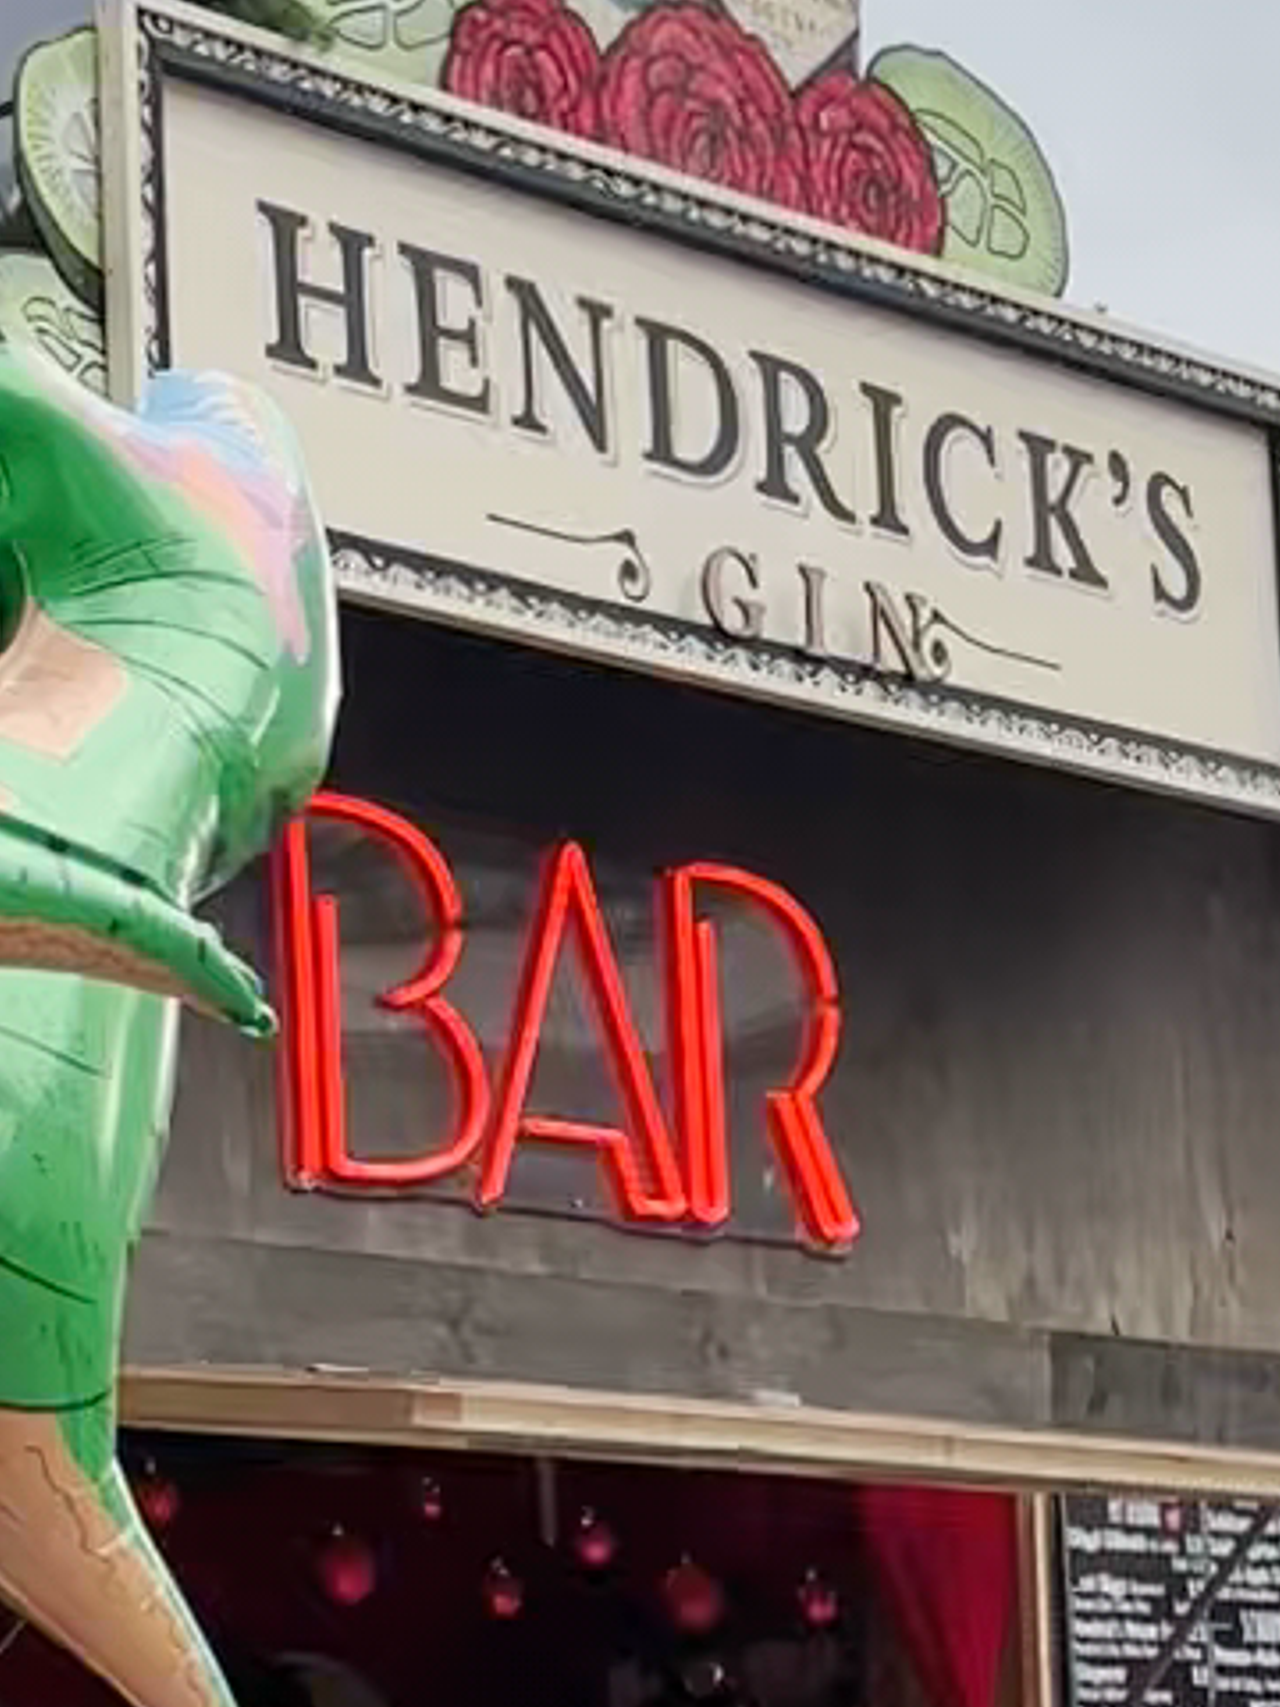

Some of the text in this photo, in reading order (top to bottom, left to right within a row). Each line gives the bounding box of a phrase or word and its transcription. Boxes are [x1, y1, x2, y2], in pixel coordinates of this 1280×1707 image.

[257, 200, 1204, 615] HENDRICK'S
[700, 545, 928, 683] GIN
[282, 790, 860, 1245] BAR
